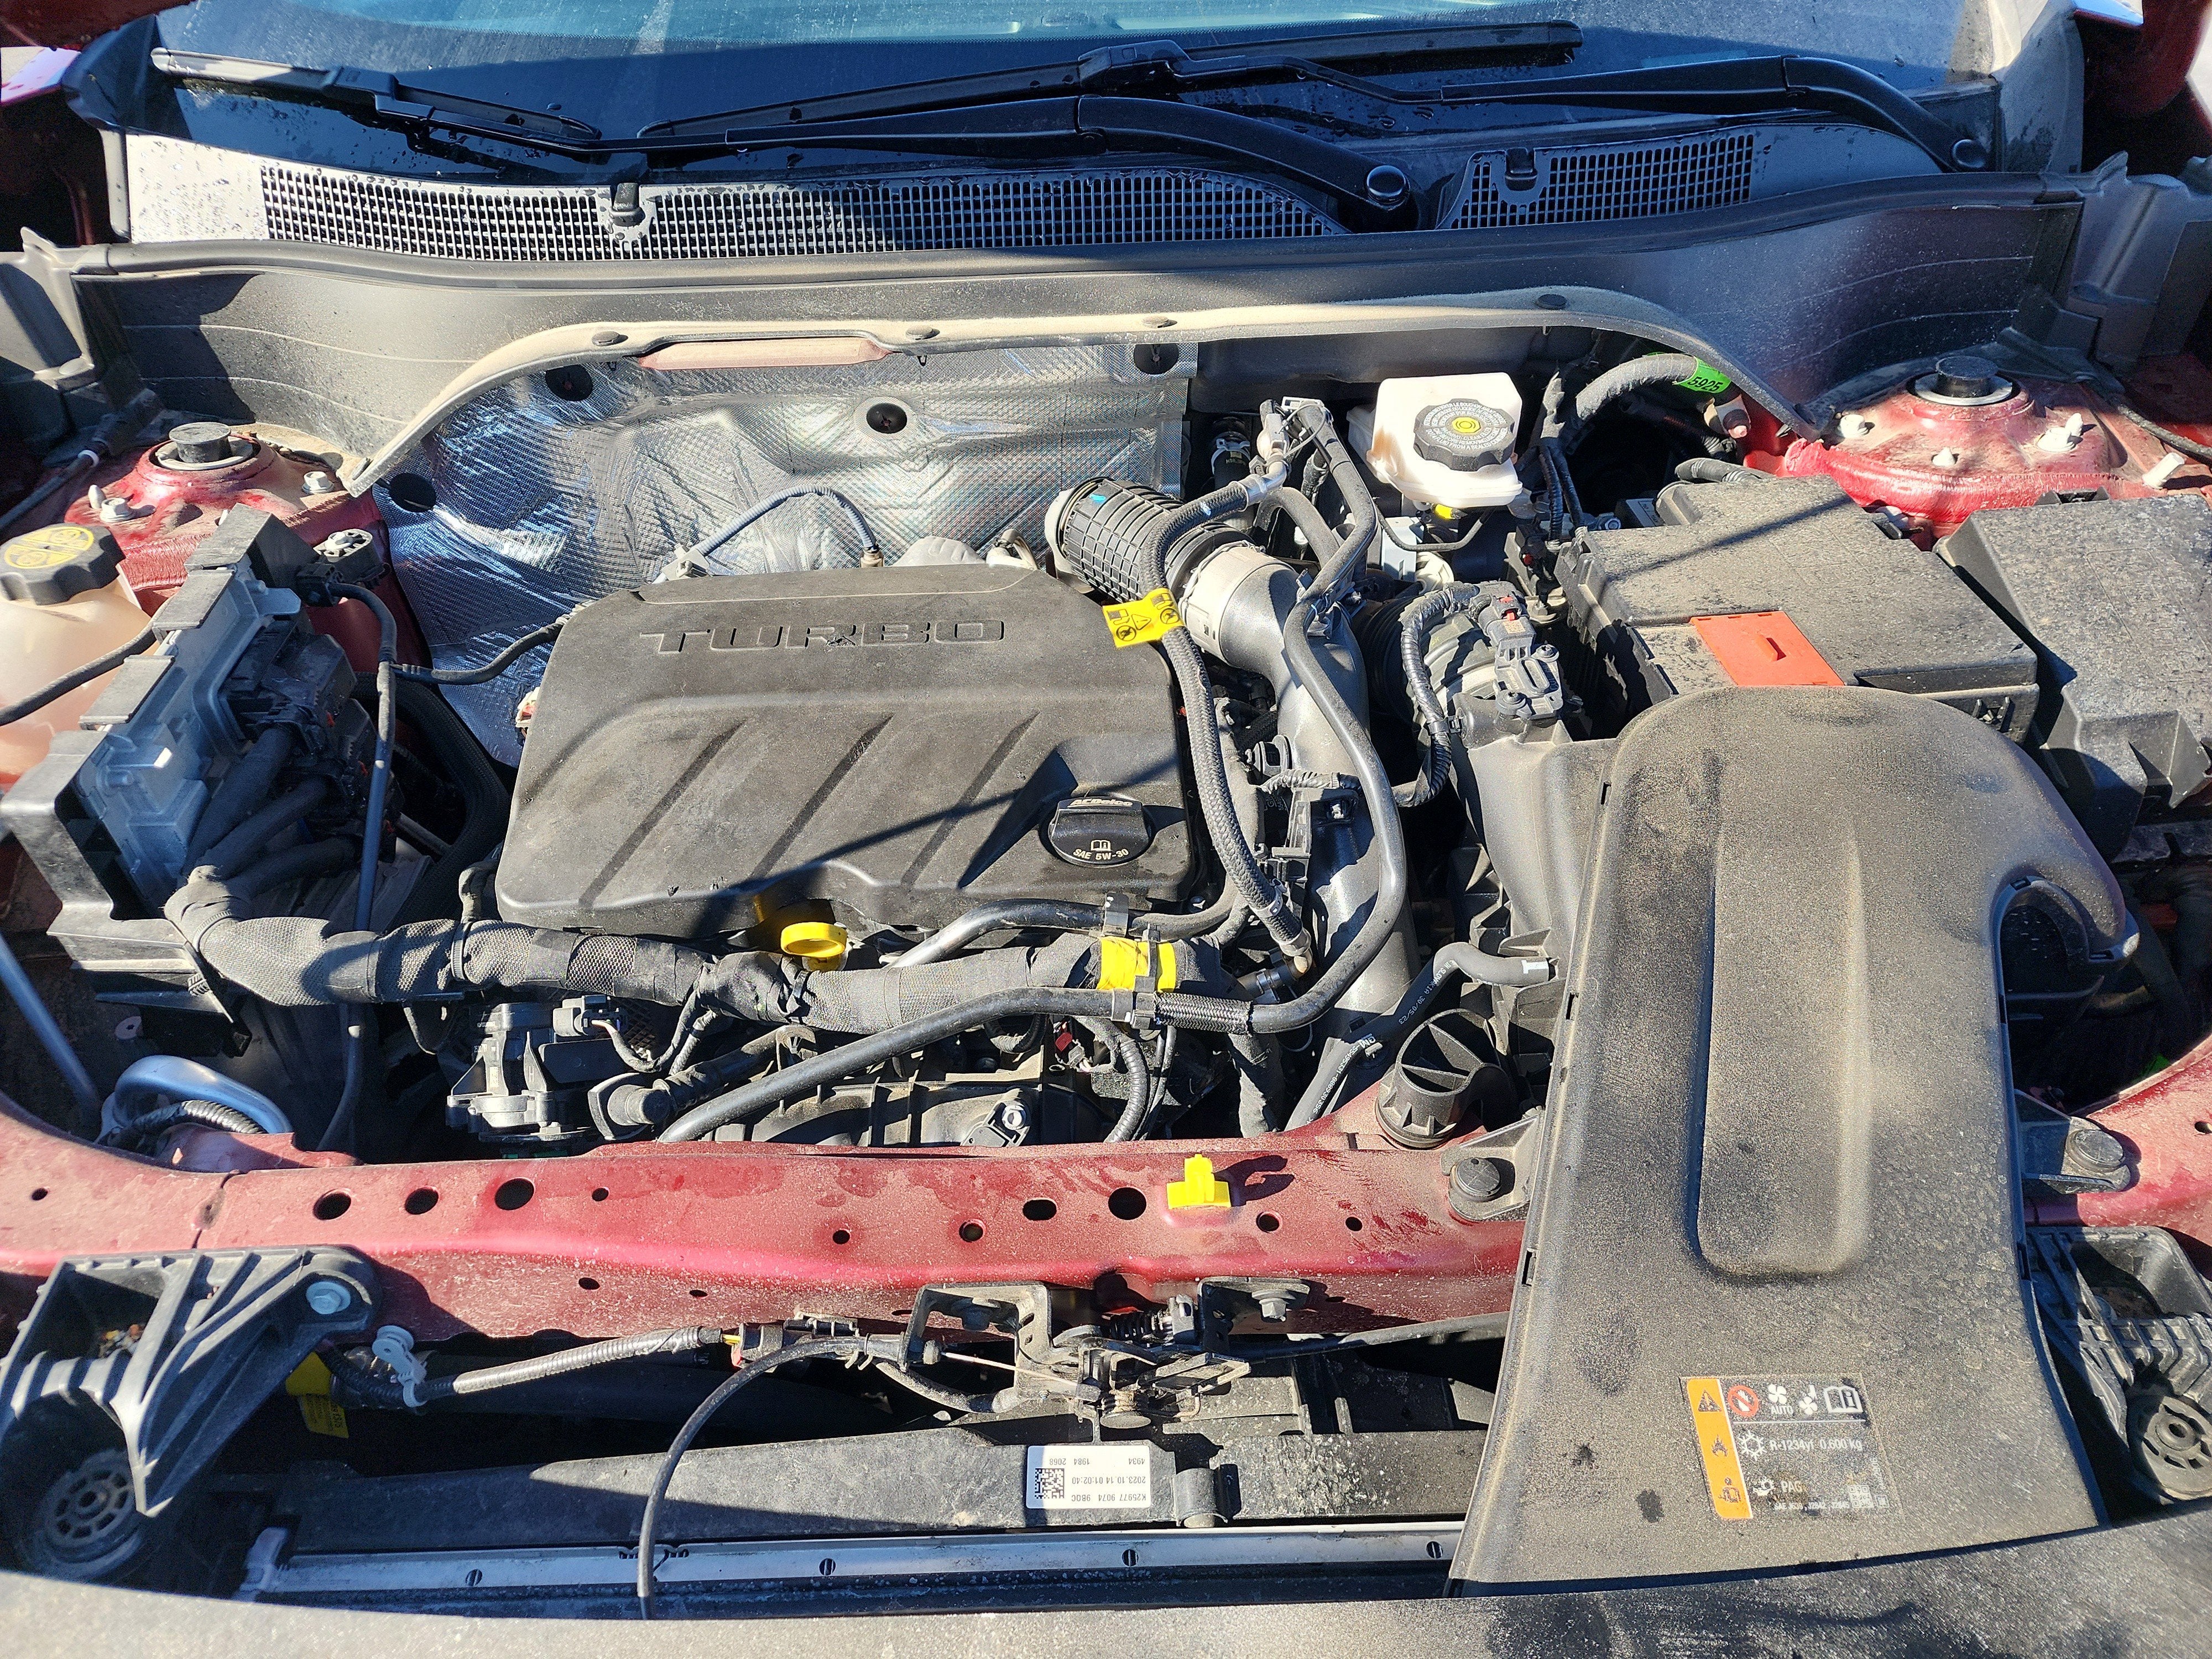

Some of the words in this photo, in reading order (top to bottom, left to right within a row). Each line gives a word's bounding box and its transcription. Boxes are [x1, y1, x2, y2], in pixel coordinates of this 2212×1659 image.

[1687, 376, 1724, 392] 5925
[1470, 441, 1492, 450] SEALED
[640, 620, 1005, 654] TURBO
[1068, 798, 1134, 807] ACDelco
[1073, 848, 1092, 859] SAE
[1095, 848, 1129, 860] 5W-30
[1424, 967, 1447, 995] SLOVAKIA
[1399, 995, 1426, 1025] 30/05/23
[1771, 1405, 1794, 1415] AUTO
[1769, 1438, 1815, 1453] R-1234yf
[1819, 1438, 1848, 1450] 0.600
[1848, 1437, 1863, 1452] kg
[1049, 1457, 1067, 1465] 2068
[1073, 1458, 1091, 1466] 1984
[1072, 1476, 1103, 1485] 01:02:40
[1780, 1479, 1803, 1493] PAG
[1098, 1493, 1116, 1501] 9074
[1119, 1493, 1146, 1501] K25977
[1773, 1501, 1787, 1510] SAE
